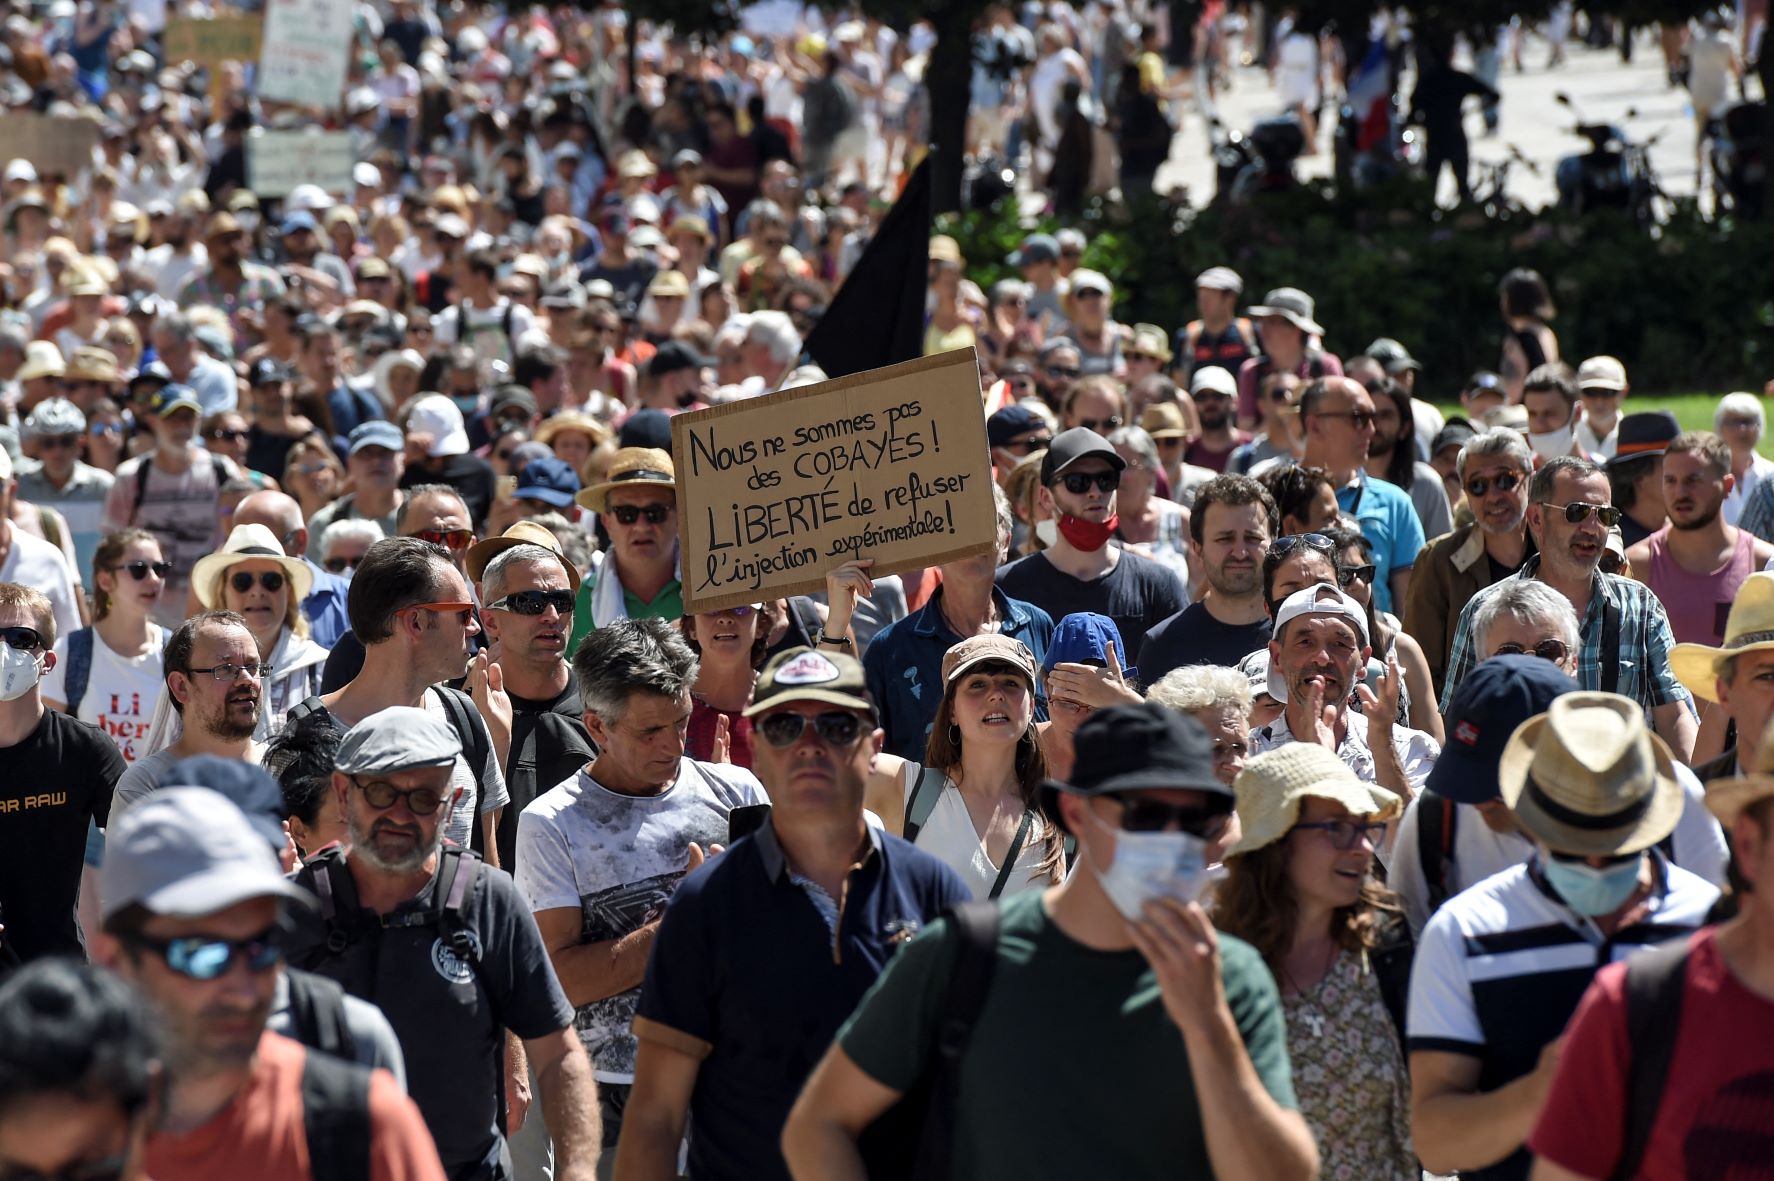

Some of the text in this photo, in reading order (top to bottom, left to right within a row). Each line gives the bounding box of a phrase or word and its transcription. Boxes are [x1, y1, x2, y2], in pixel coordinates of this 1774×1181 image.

[689, 400, 922, 476] Nous ne sommes pas
[747, 465, 782, 490] des
[793, 430, 925, 479] COBAYES
[847, 482, 876, 517] de
[885, 472, 971, 522] refuser
[696, 542, 817, 591] l'injection
[109, 692, 140, 715] Li
[24, 791, 67, 810] RAW
